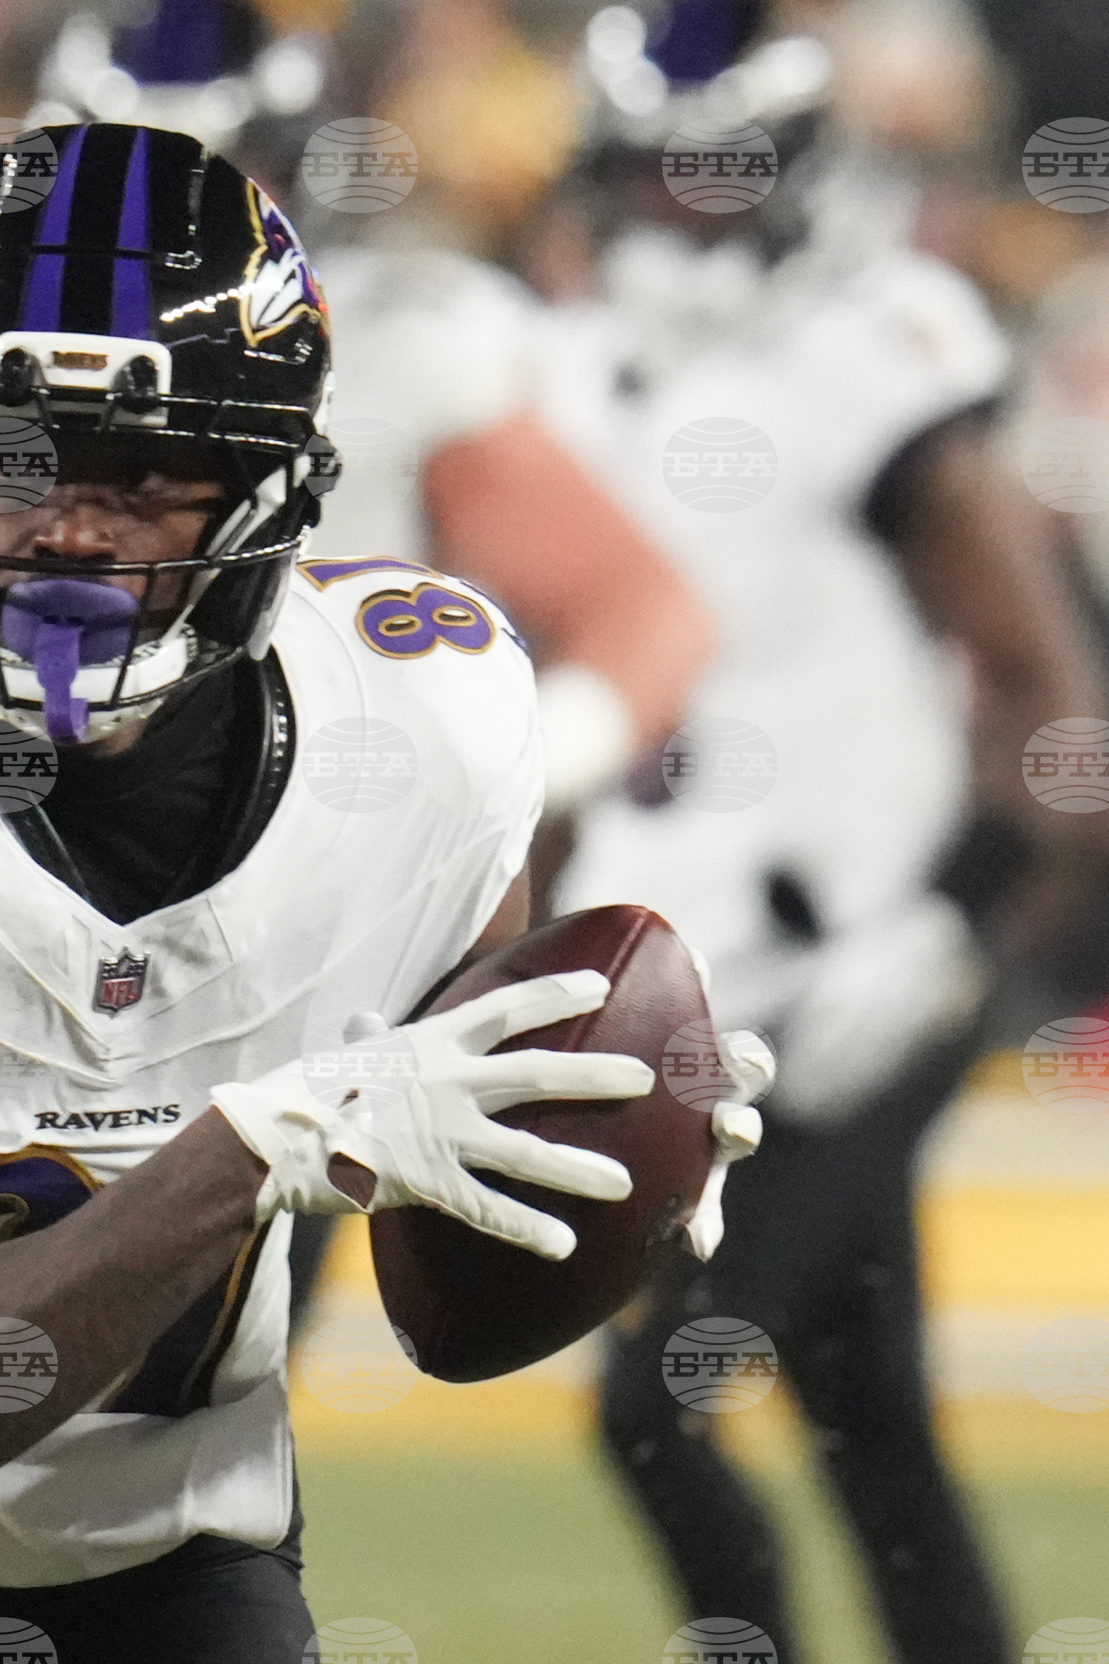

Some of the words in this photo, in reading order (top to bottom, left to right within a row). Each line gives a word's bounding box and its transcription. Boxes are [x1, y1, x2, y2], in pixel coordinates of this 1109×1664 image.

[295, 555, 496, 660] 81
[101, 981, 140, 1006] NFL
[34, 1103, 181, 1132] RAVENS
